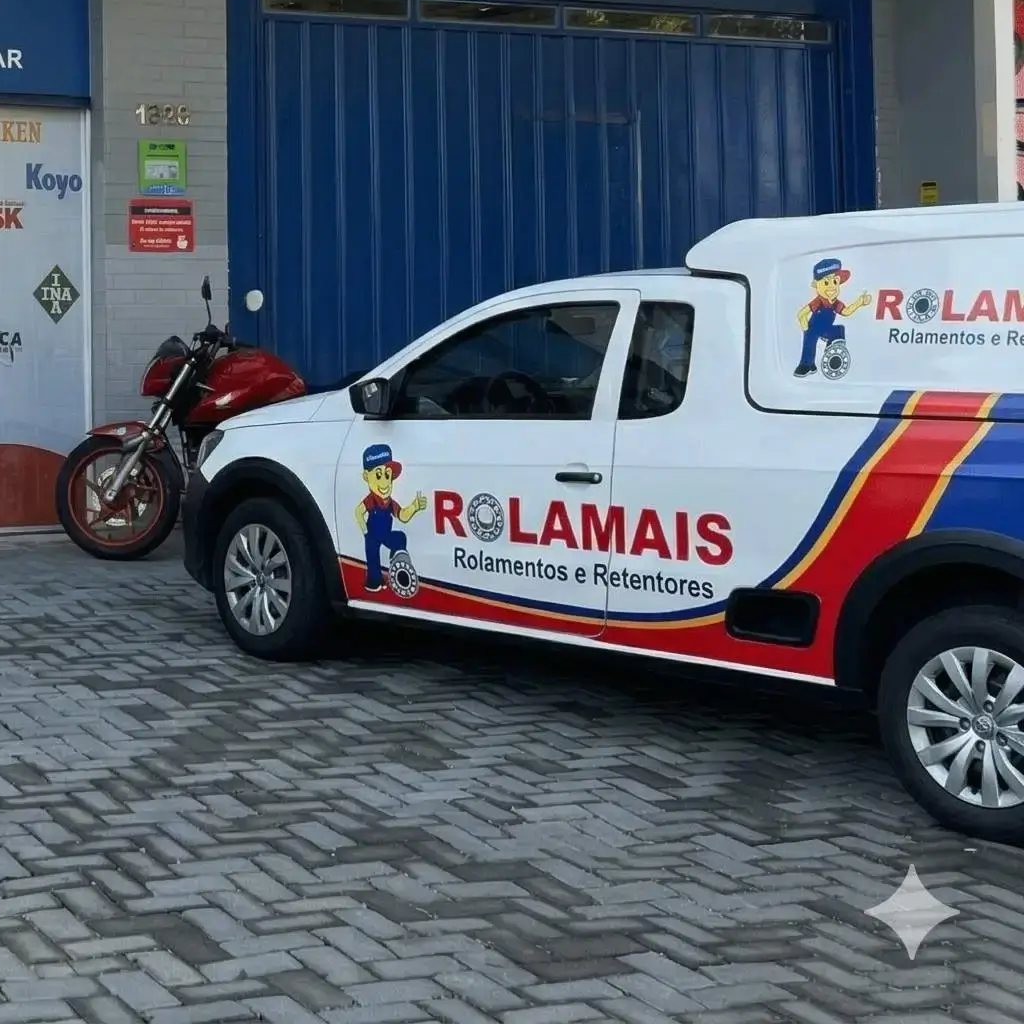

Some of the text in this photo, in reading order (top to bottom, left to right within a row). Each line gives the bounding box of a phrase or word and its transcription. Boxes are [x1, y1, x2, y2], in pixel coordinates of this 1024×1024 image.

[26, 163, 83, 199] Koyo
[888, 328, 985, 345] Rolamentos
[991, 333, 1001, 346] e
[433, 489, 734, 567] ROLAMAIS
[455, 547, 714, 599] Rolamentos e Retentores
